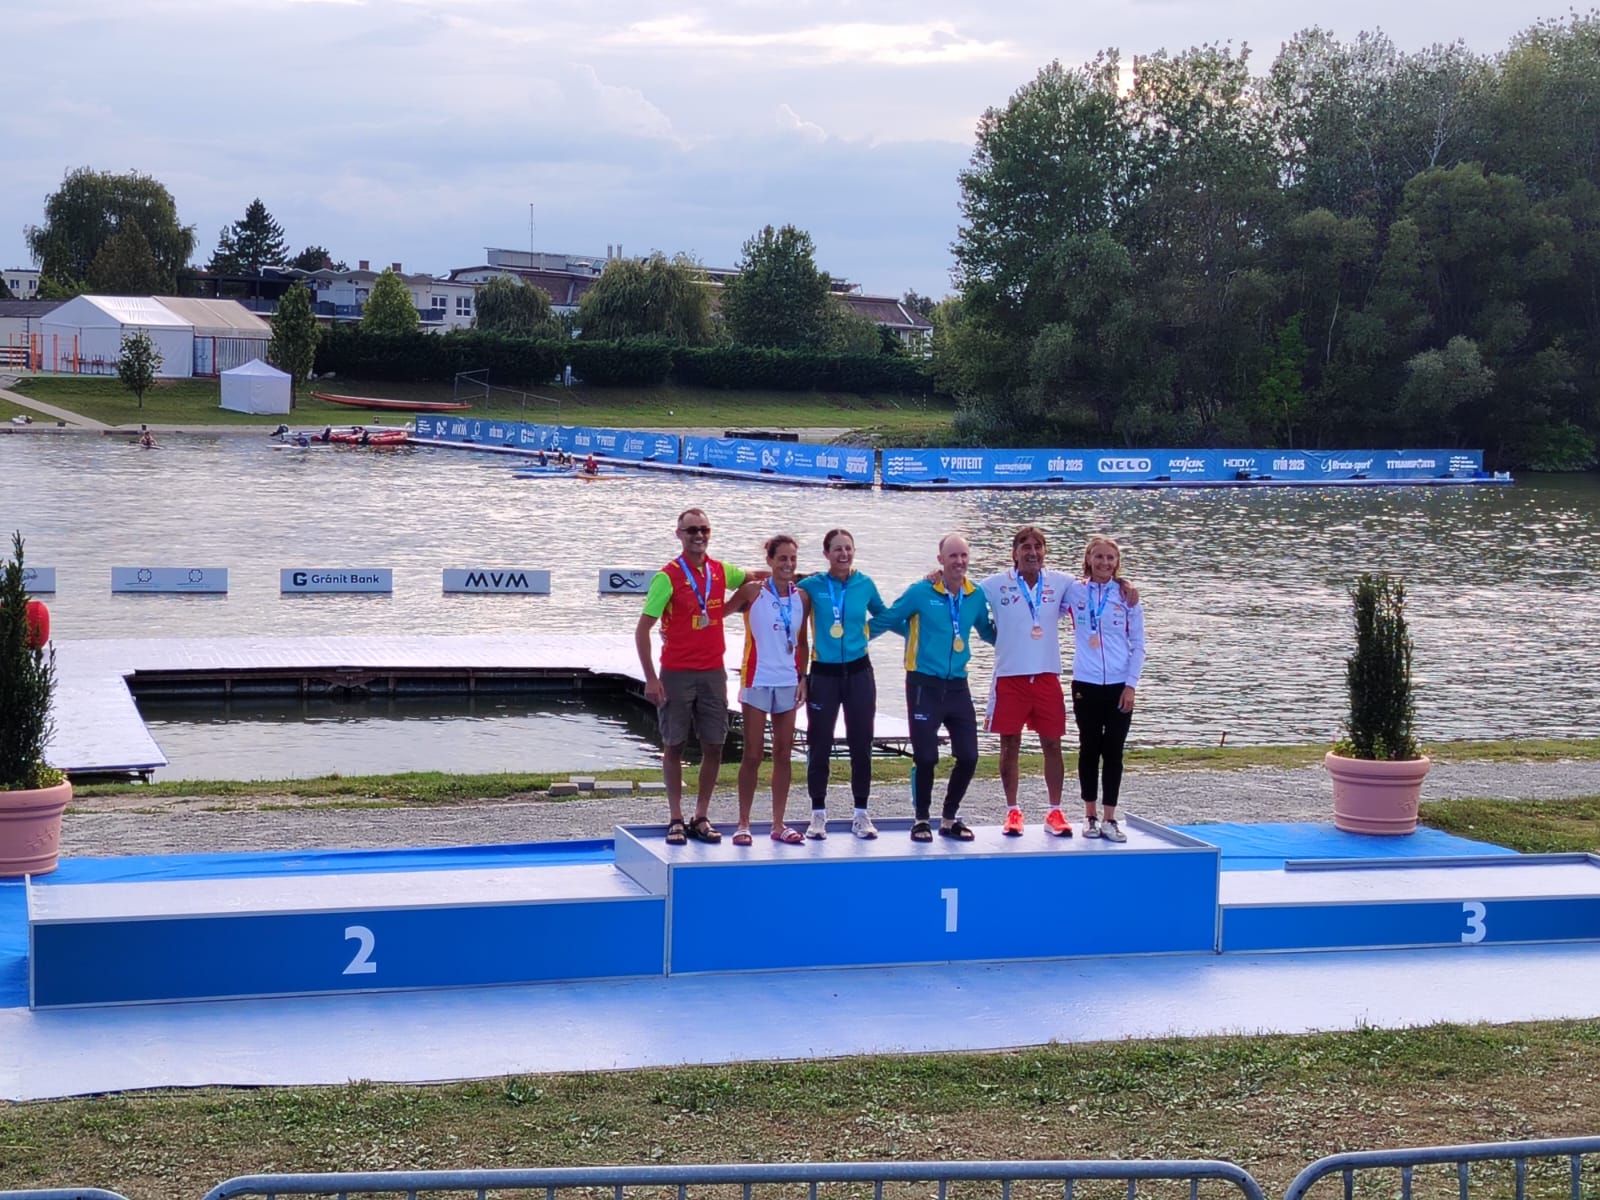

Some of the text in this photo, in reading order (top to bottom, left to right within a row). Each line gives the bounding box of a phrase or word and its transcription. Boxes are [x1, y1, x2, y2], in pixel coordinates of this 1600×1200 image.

[951, 457, 983, 470] PATENT
[1065, 459, 1083, 471] 2025
[1100, 460, 1150, 471] NELO
[1288, 459, 1305, 471] 2025
[311, 572, 348, 585] Gránit
[350, 573, 380, 585] Bank
[465, 572, 529, 588] MVM
[941, 887, 958, 932] 1
[1462, 902, 1486, 944] 3
[342, 925, 376, 975] 2
